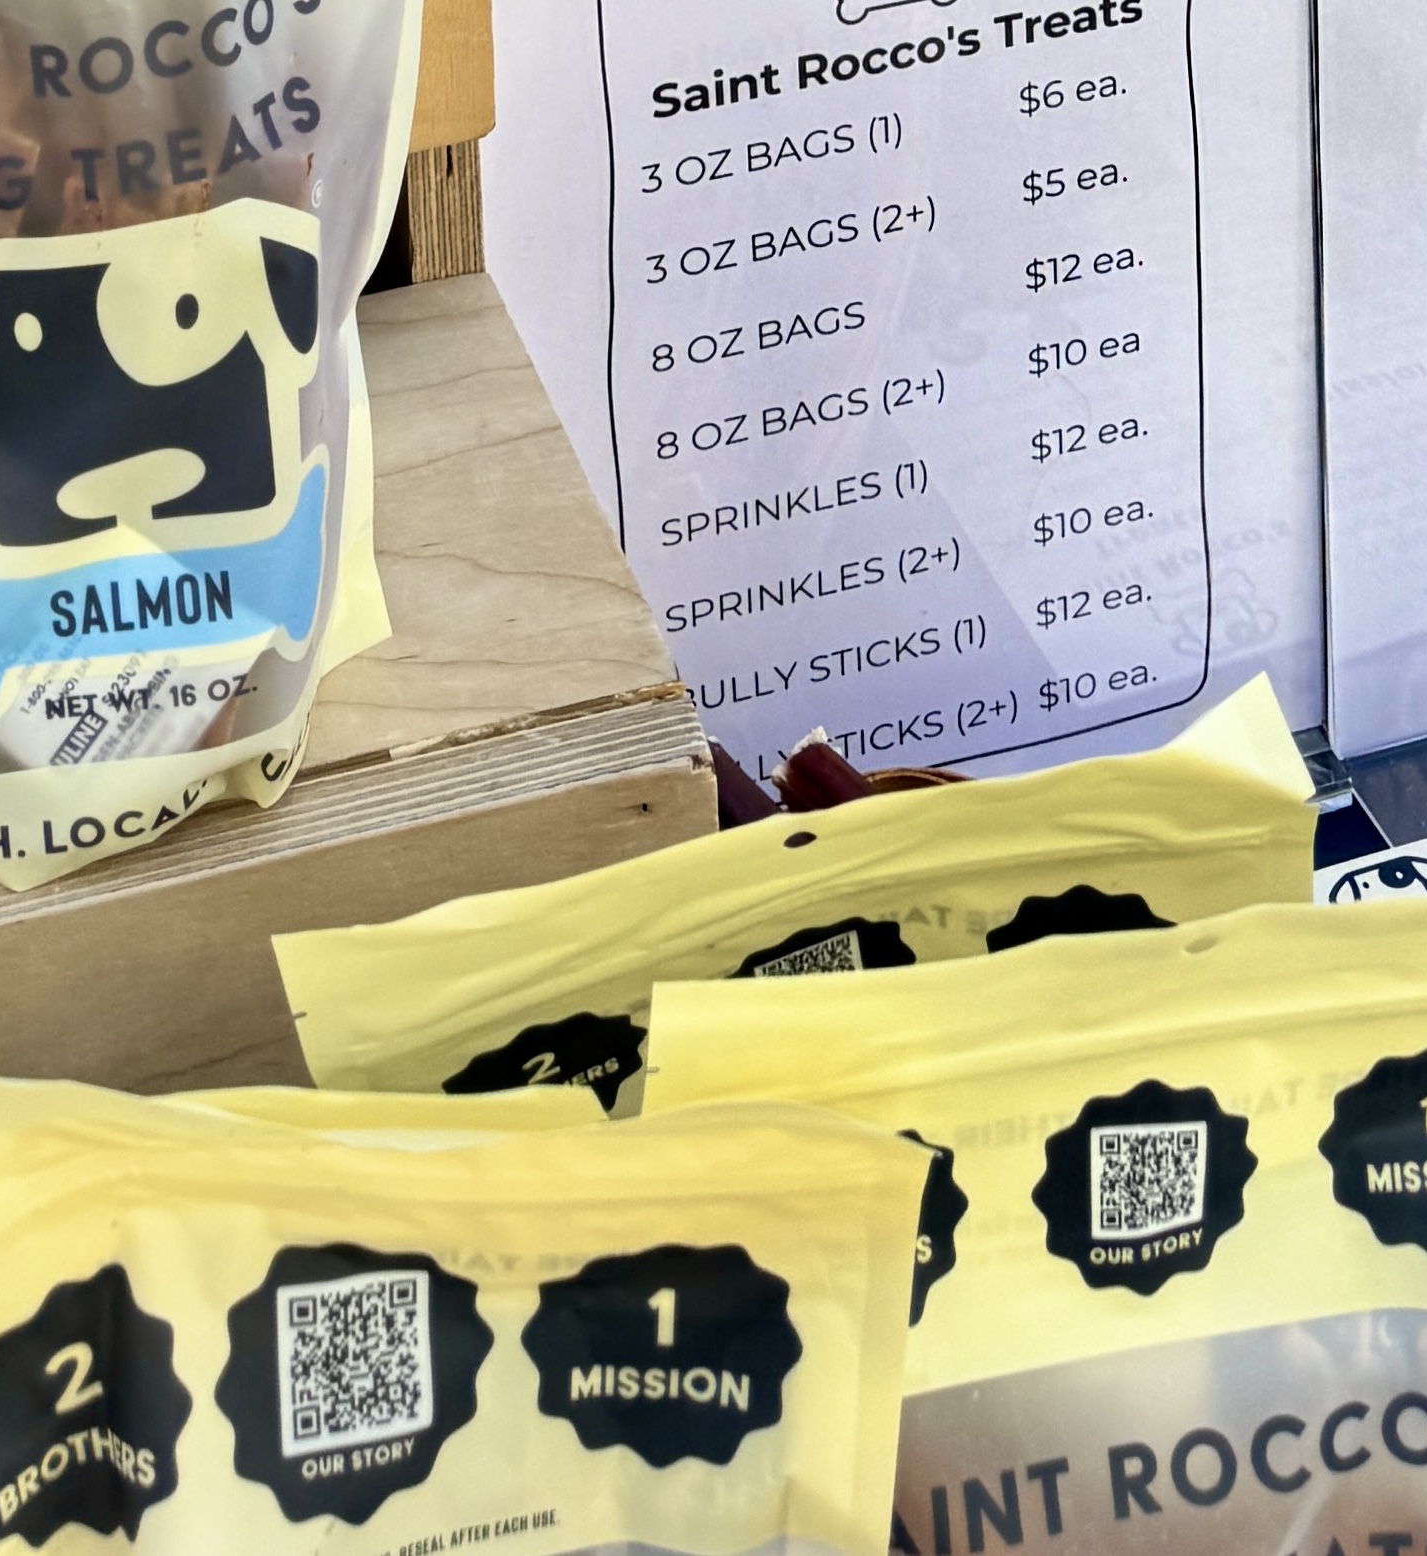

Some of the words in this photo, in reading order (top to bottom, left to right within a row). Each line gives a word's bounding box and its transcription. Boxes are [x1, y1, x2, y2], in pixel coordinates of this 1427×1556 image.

[652, 64, 781, 118] Saint
[798, 26, 981, 89] Rocco's
[70, 76, 322, 202] TREATS
[641, 163, 662, 193] 3
[675, 148, 734, 185] OZ
[747, 124, 855, 172] BAGS
[869, 112, 901, 154] (1)
[1020, 80, 1064, 118] $6
[1076, 76, 1126, 102] ea.
[657, 431, 679, 460] 8
[692, 414, 749, 451] OZ
[762, 387, 869, 437] BAGS
[883, 369, 944, 416] (2+)
[1029, 339, 1087, 378] $10
[1099, 332, 1140, 358] ea
[661, 472, 881, 547] SPRINKLES
[896, 459, 927, 499] (1)
[1031, 424, 1087, 464] $12
[1098, 419, 1148, 444] ea.
[50, 571, 233, 637] SALMON
[169, 684, 196, 707] 16
[208, 673, 259, 702] OZ.
[1090, 1248, 1133, 1264] OUR
[1142, 1229, 1202, 1261] STORY
[571, 1365, 750, 1411] MISSION
